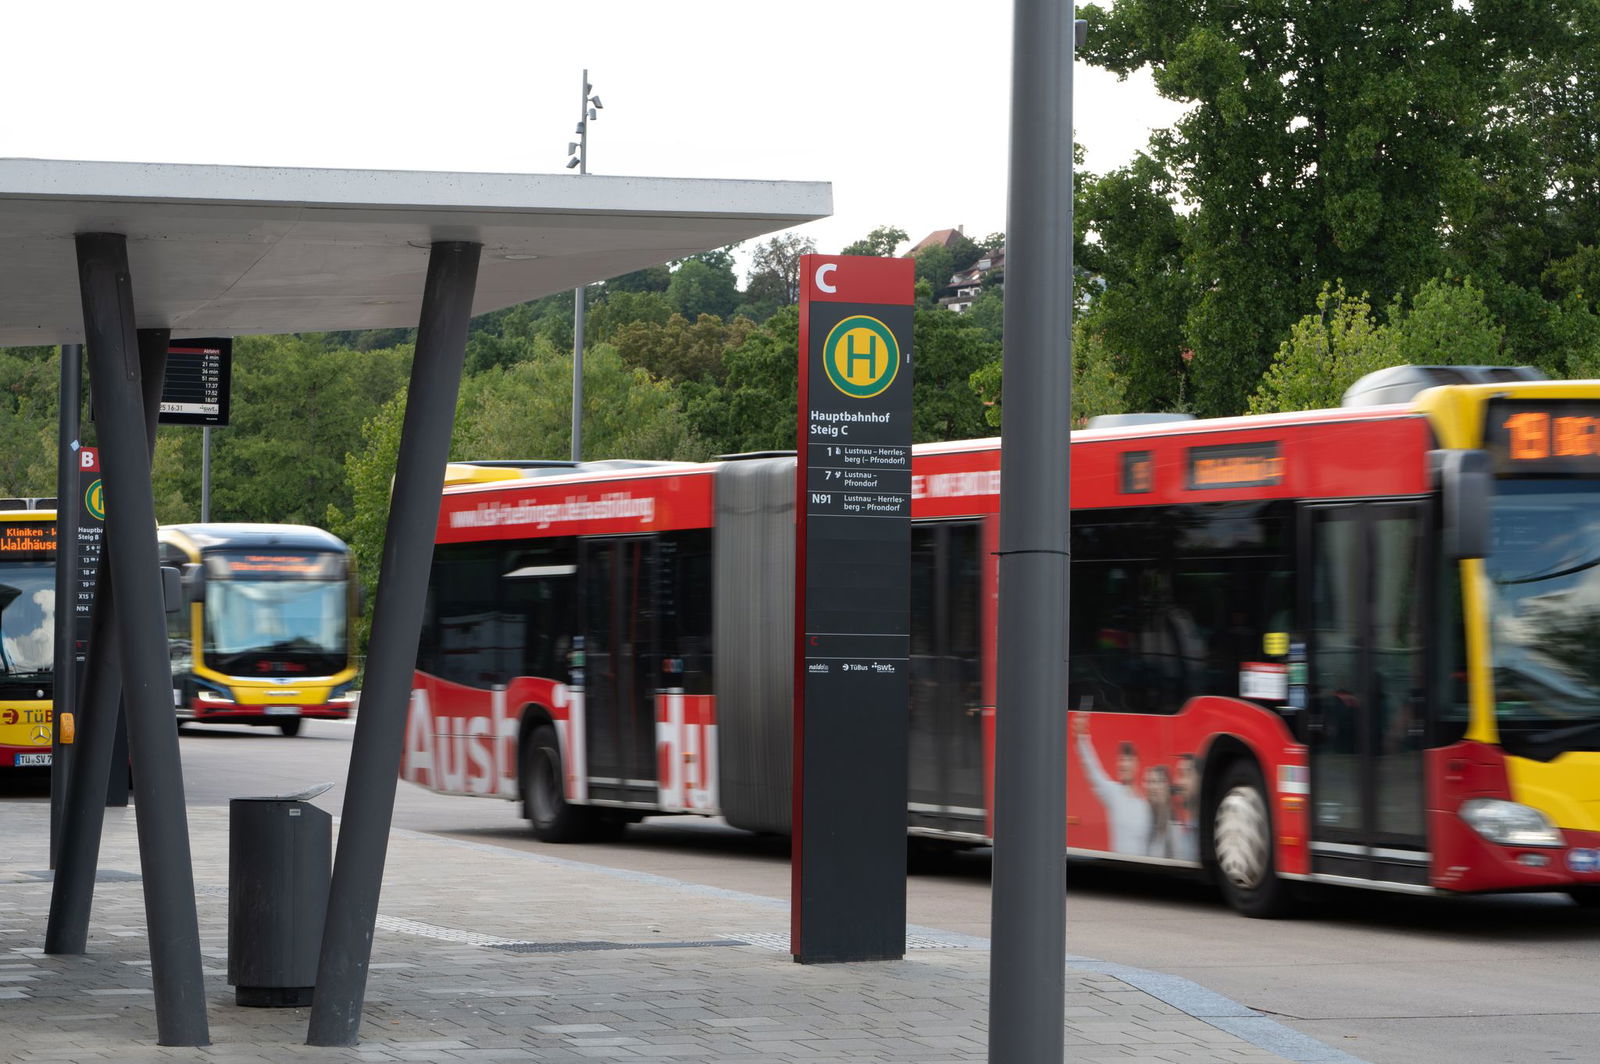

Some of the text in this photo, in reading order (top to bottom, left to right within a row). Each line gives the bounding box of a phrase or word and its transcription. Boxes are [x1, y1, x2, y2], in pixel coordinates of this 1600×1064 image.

[815, 263, 837, 293] C
[810, 410, 890, 423] Hauptbahnhof
[810, 424, 848, 437] Steig C
[827, 447, 832, 456] 1
[82, 452, 94, 467] B
[844, 456, 860, 464] berg
[870, 456, 906, 464] Pfrondorf)
[825, 471, 832, 480] 7
[812, 494, 831, 504] N91
[844, 504, 860, 512] berg
[6, 528, 42, 536] Kliniken
[36, 755, 46, 764] SV
